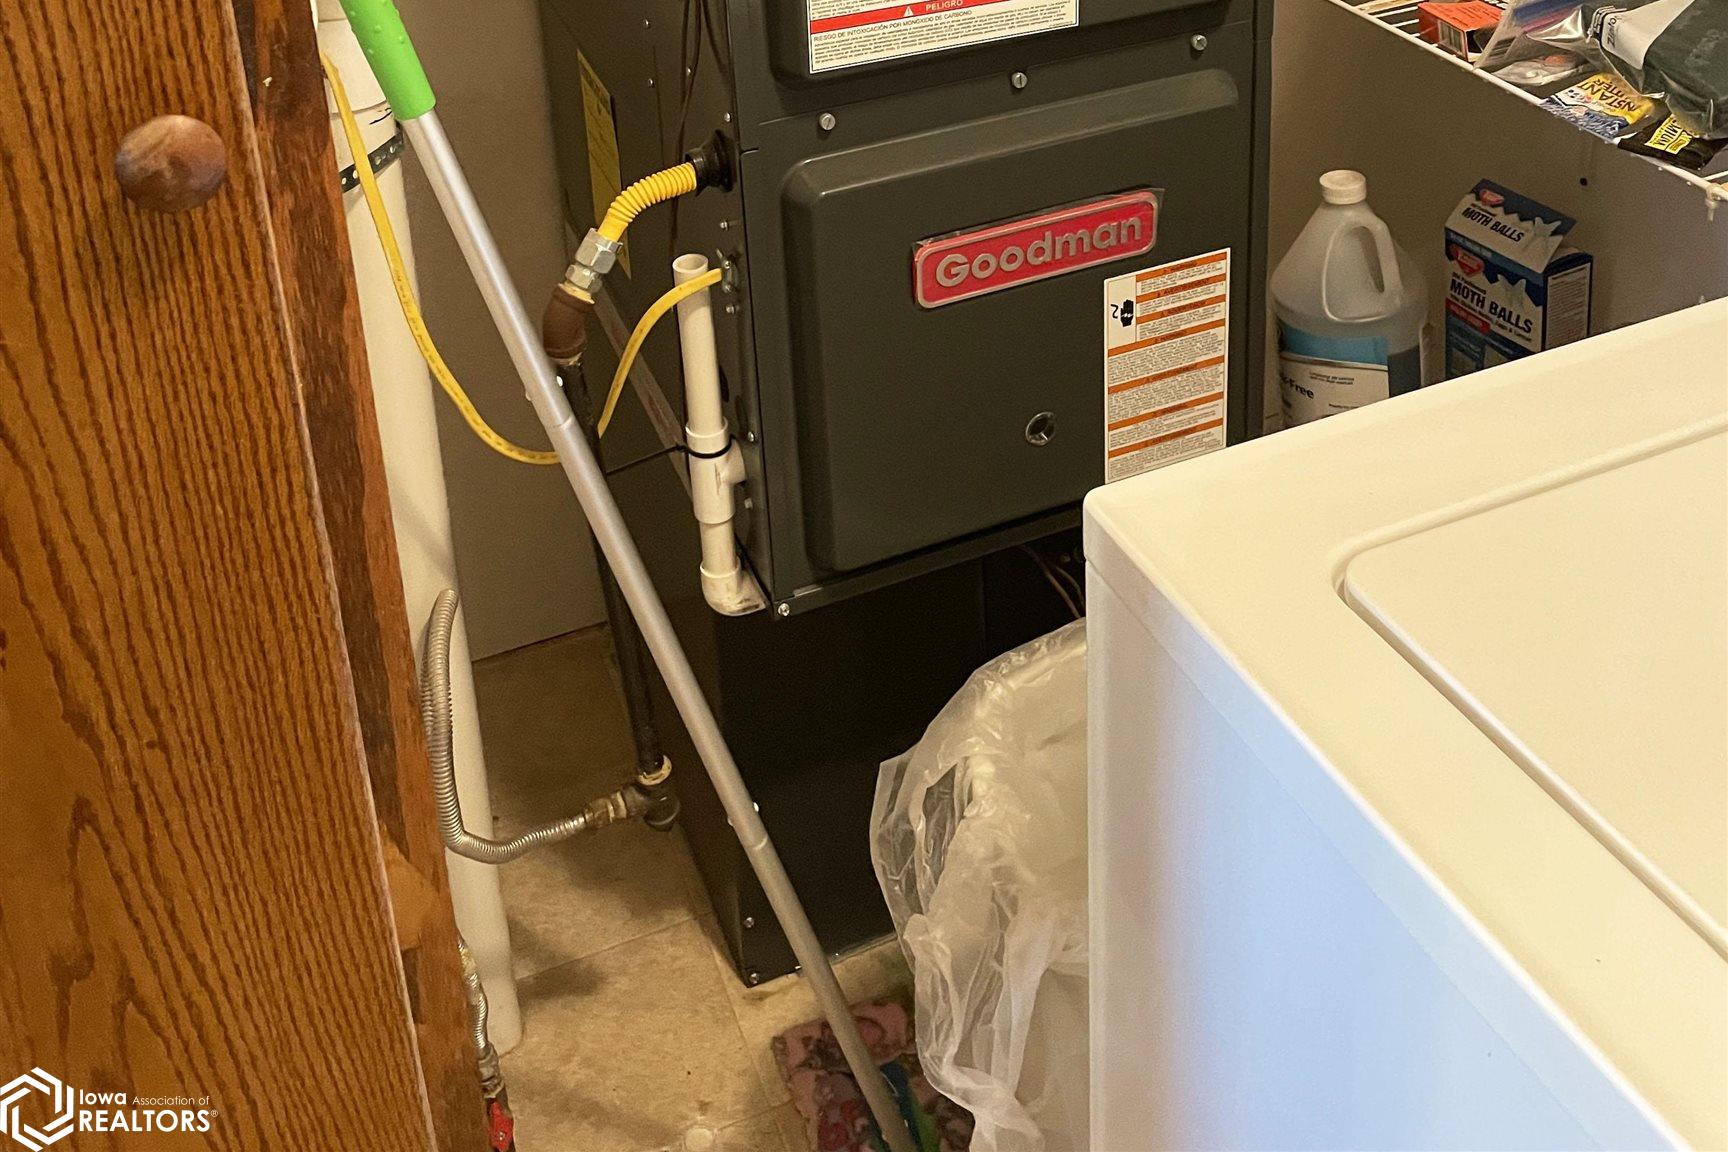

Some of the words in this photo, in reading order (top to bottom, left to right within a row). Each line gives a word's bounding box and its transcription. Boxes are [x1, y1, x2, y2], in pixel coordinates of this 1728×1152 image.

[925, 0, 963, 11] PELIGRO
[1462, 206, 1492, 226] MOTH
[1490, 221, 1525, 243] BALLS
[935, 215, 1143, 289] Goodman
[1450, 278, 1485, 309] MOTH
[1489, 300, 1533, 334] BALLS
